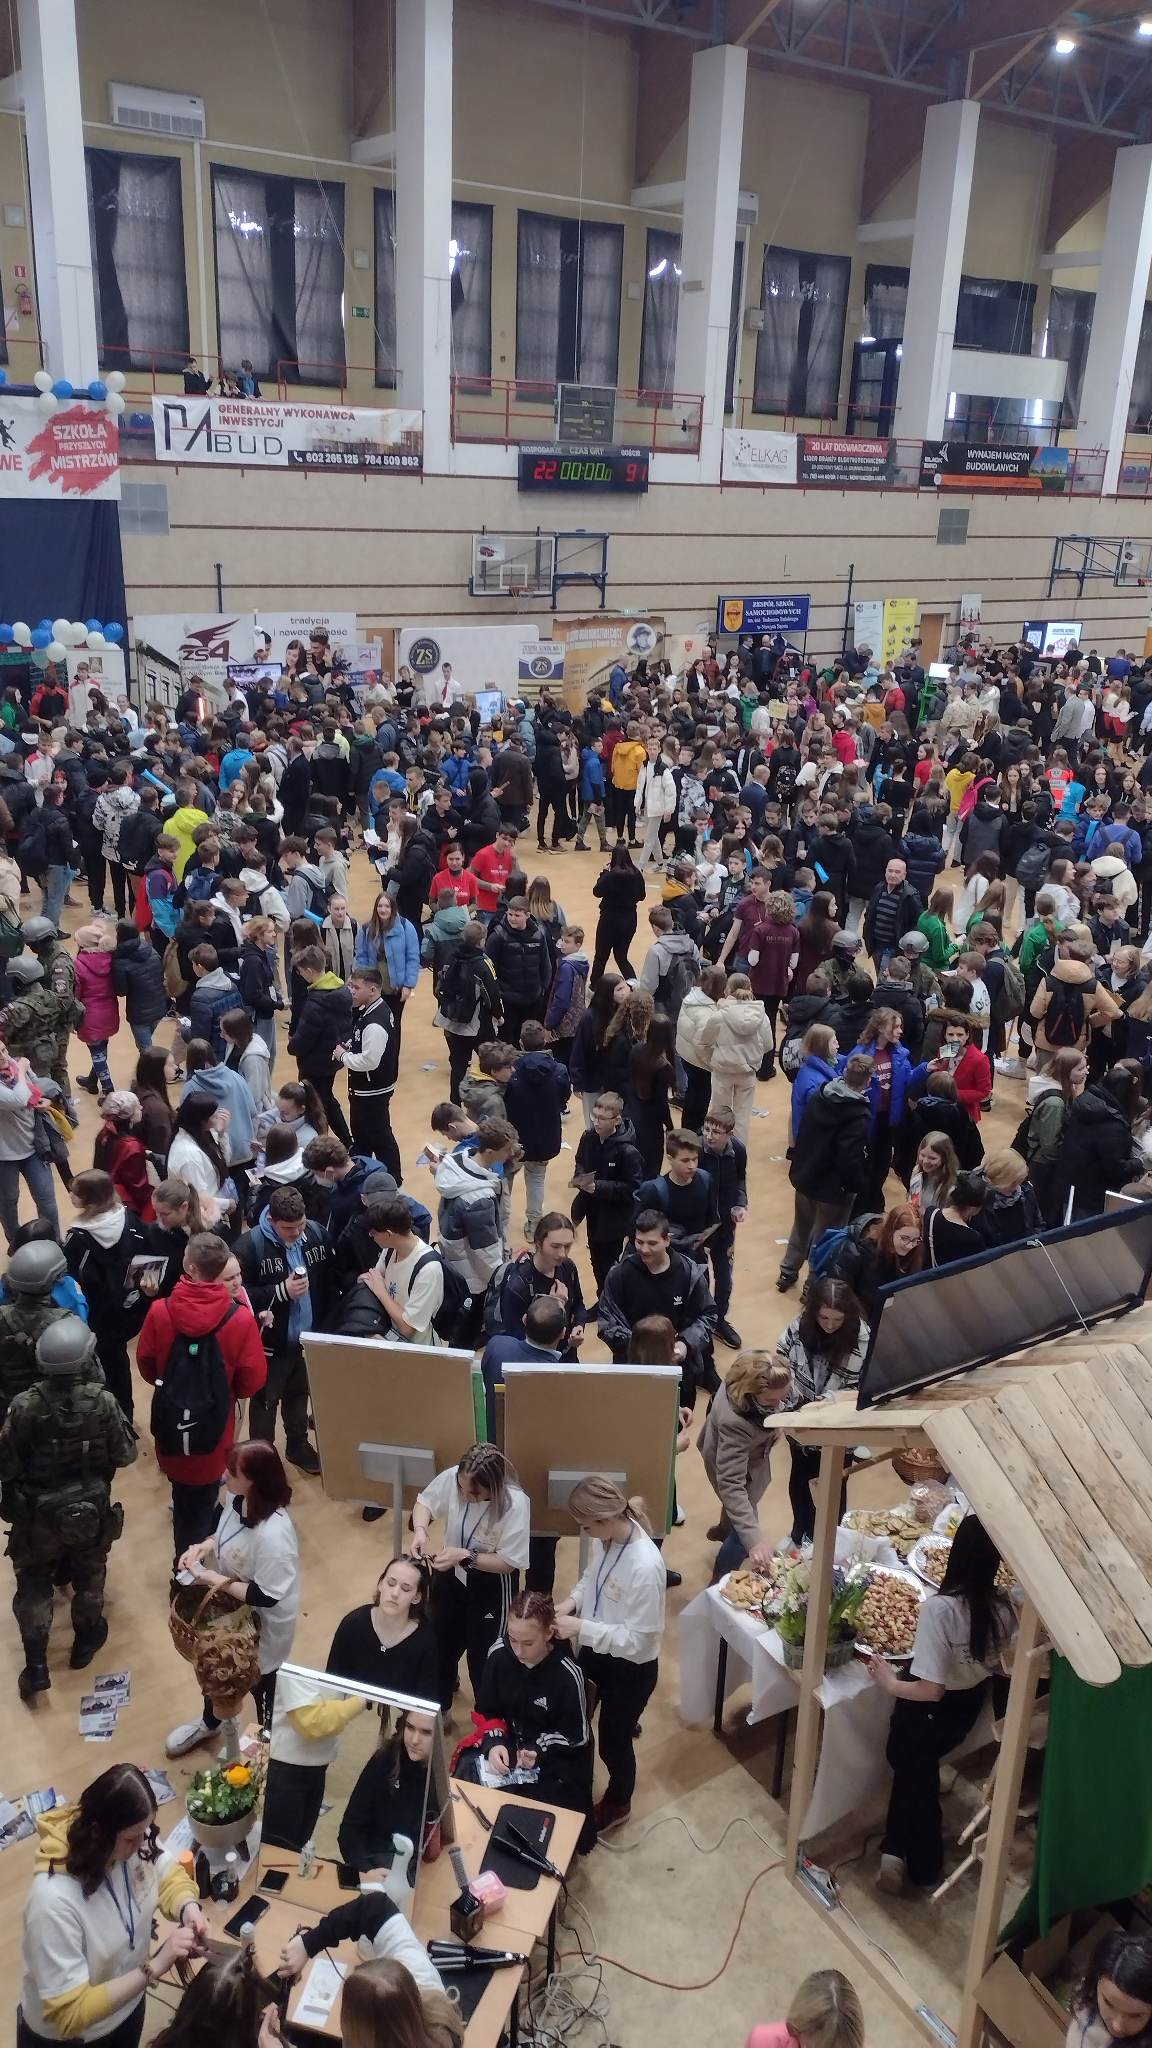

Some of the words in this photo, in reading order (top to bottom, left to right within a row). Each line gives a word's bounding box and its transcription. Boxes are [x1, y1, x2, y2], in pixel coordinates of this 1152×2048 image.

[218, 404, 280, 415] GENERALNY
[283, 408, 355, 420] WYKONAWCA
[219, 416, 284, 428] INWESTYCJI
[52, 423, 107, 440] SZKOŁA
[58, 440, 106, 451] PRZYSZŁYCH
[569, 447, 588, 455] CZAS
[589, 447, 604, 455] GRY
[812, 442, 820, 451] 20
[821, 442, 833, 452] LAT
[834, 442, 882, 453] DOŚWIADCZENIA
[50, 451, 118, 471] MISTRZÓW
[306, 452, 324, 462] 602
[343, 454, 359, 464] 125
[750, 448, 788, 464] ELKAG
[967, 450, 1002, 460] WYNAJEM
[534, 460, 558, 480] 22
[965, 462, 1019, 472] BUDOWLANYCH
[290, 616, 329, 625] tradycja
